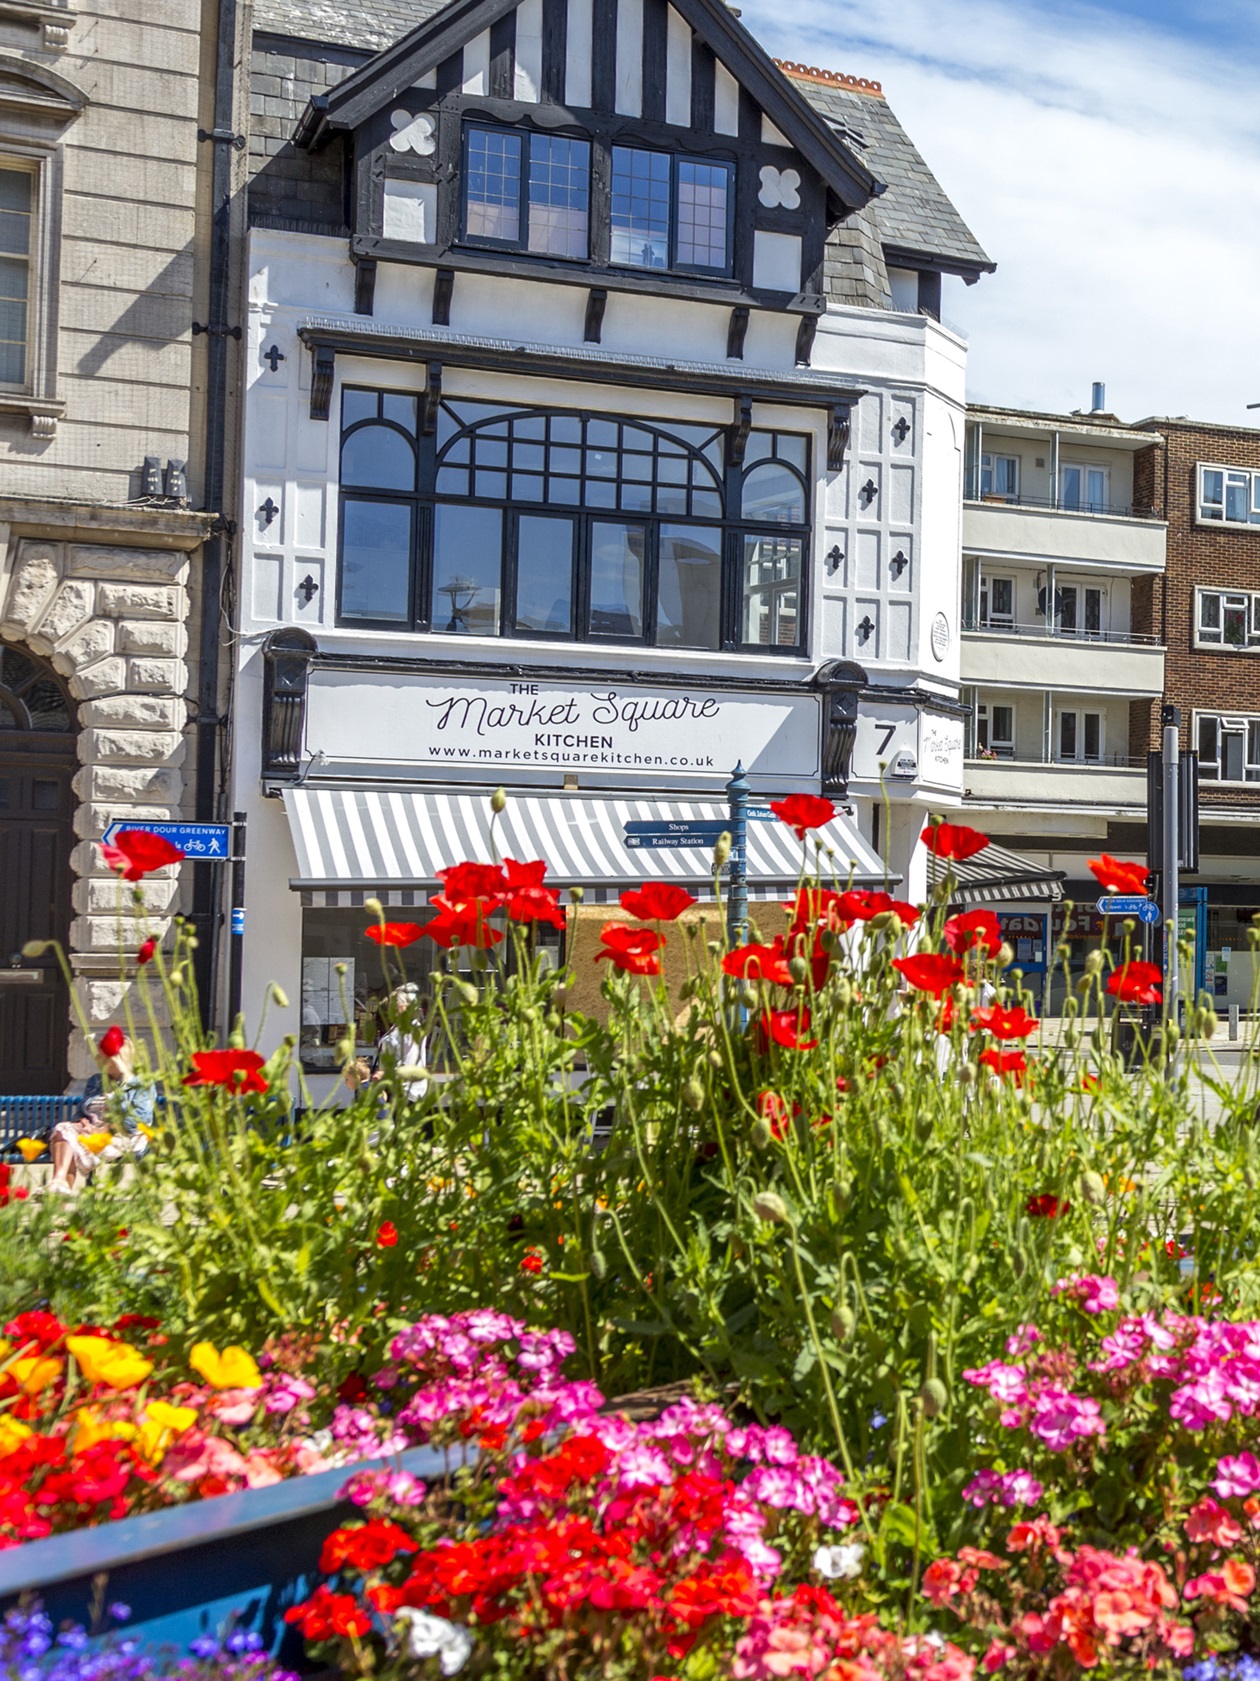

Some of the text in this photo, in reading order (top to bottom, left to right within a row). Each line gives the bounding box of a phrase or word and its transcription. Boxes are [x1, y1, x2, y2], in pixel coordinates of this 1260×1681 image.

[509, 683, 539, 696] THE
[426, 692, 720, 736] Market Square
[534, 733, 613, 749] KITCHEN
[874, 724, 896, 755] 7
[429, 746, 714, 767] www.marketsquarekitchen.co.uk
[153, 826, 177, 834] DOUR
[179, 827, 225, 835] GREENWAY
[669, 823, 689, 831] Shops
[652, 837, 704, 846] Railway Station
